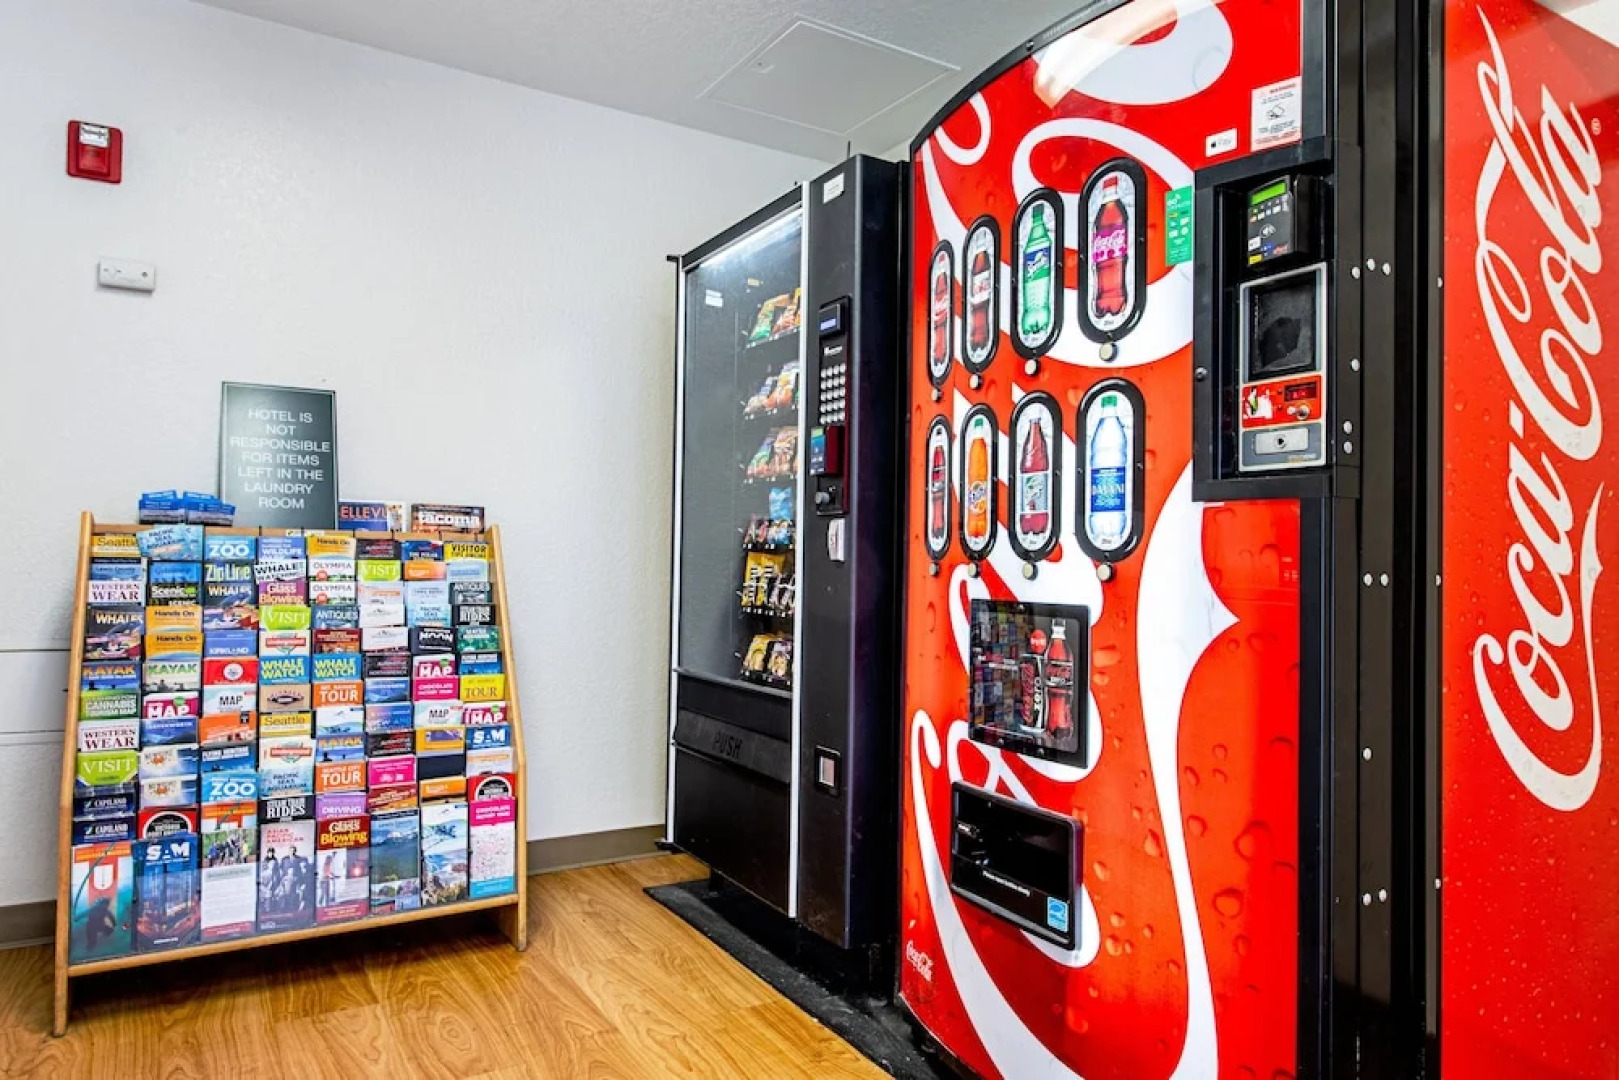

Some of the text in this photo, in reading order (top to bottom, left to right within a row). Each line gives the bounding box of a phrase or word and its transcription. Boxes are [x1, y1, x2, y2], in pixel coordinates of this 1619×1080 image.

[1473, 5, 1604, 811] Coca-Cola
[248, 408, 314, 424] HOTEL IS
[267, 424, 296, 436] NOT
[231, 437, 331, 452] RESPONSIBLE
[242, 452, 320, 466] FOR ITEMS
[237, 466, 325, 481] LEFT IN THE
[245, 482, 314, 494] LAUNDRY
[259, 497, 305, 509] ROOM
[209, 544, 249, 558] ZOO
[452, 544, 486, 554] VISITOR
[313, 562, 352, 570] OLYMPIA
[364, 563, 397, 576] VISIT
[91, 582, 140, 591] WESTERN
[151, 584, 185, 596] Scenic
[313, 584, 352, 592] OLYMPIA
[92, 591, 140, 601] WEAR
[267, 611, 309, 624] VISIT
[316, 610, 358, 621] ANTIQUES
[148, 664, 197, 674] KAYAK
[261, 658, 304, 671] WHALE
[315, 658, 355, 669] WHALE
[262, 668, 304, 679] WATCH
[316, 666, 356, 678] WATCH
[420, 666, 453, 678] MAP
[320, 690, 358, 702] TOUR
[464, 686, 498, 698] TOUR
[86, 700, 136, 710] CANNABIS
[219, 696, 244, 706] MAP
[148, 702, 190, 718] MAP
[429, 709, 450, 720] MAP
[264, 716, 306, 726] Seattle
[470, 711, 502, 724] MAP
[84, 729, 136, 739] WESTERN
[85, 738, 136, 750] WEAR
[713, 732, 743, 759] PUSH
[83, 759, 134, 775] VISIT
[322, 772, 362, 786] TOUR
[210, 782, 255, 796] ZOO
[267, 804, 306, 818] RIDES
[322, 806, 362, 814] DRIVING
[329, 820, 361, 833] Glass
[320, 831, 368, 846] Blowing
